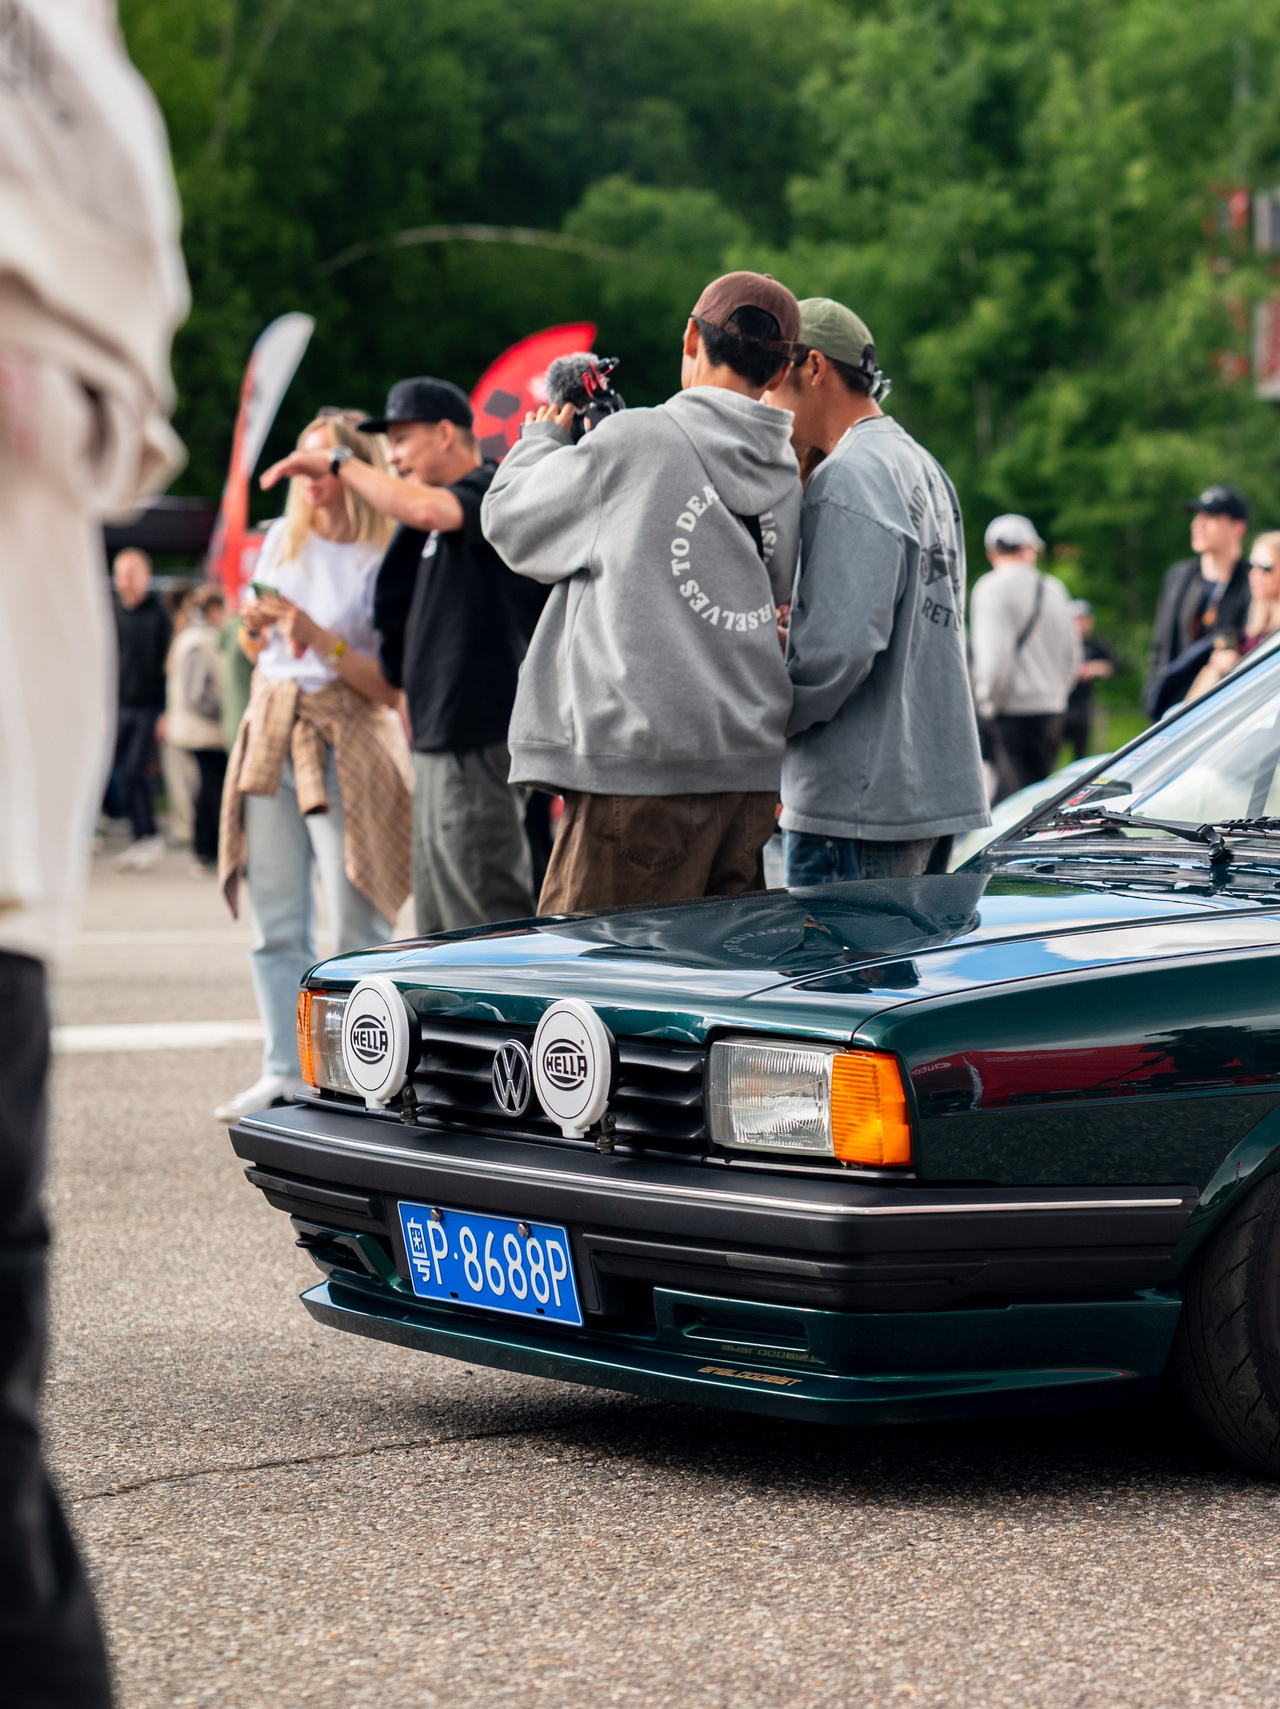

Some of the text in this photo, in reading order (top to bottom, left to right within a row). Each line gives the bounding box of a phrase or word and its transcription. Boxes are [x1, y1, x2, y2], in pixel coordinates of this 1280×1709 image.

[676, 484, 720, 533] DEA
[670, 537, 691, 576] TO
[679, 579, 773, 632] RSELVES
[353, 1029, 388, 1052] HELLA
[546, 1054, 588, 1078] HELLA
